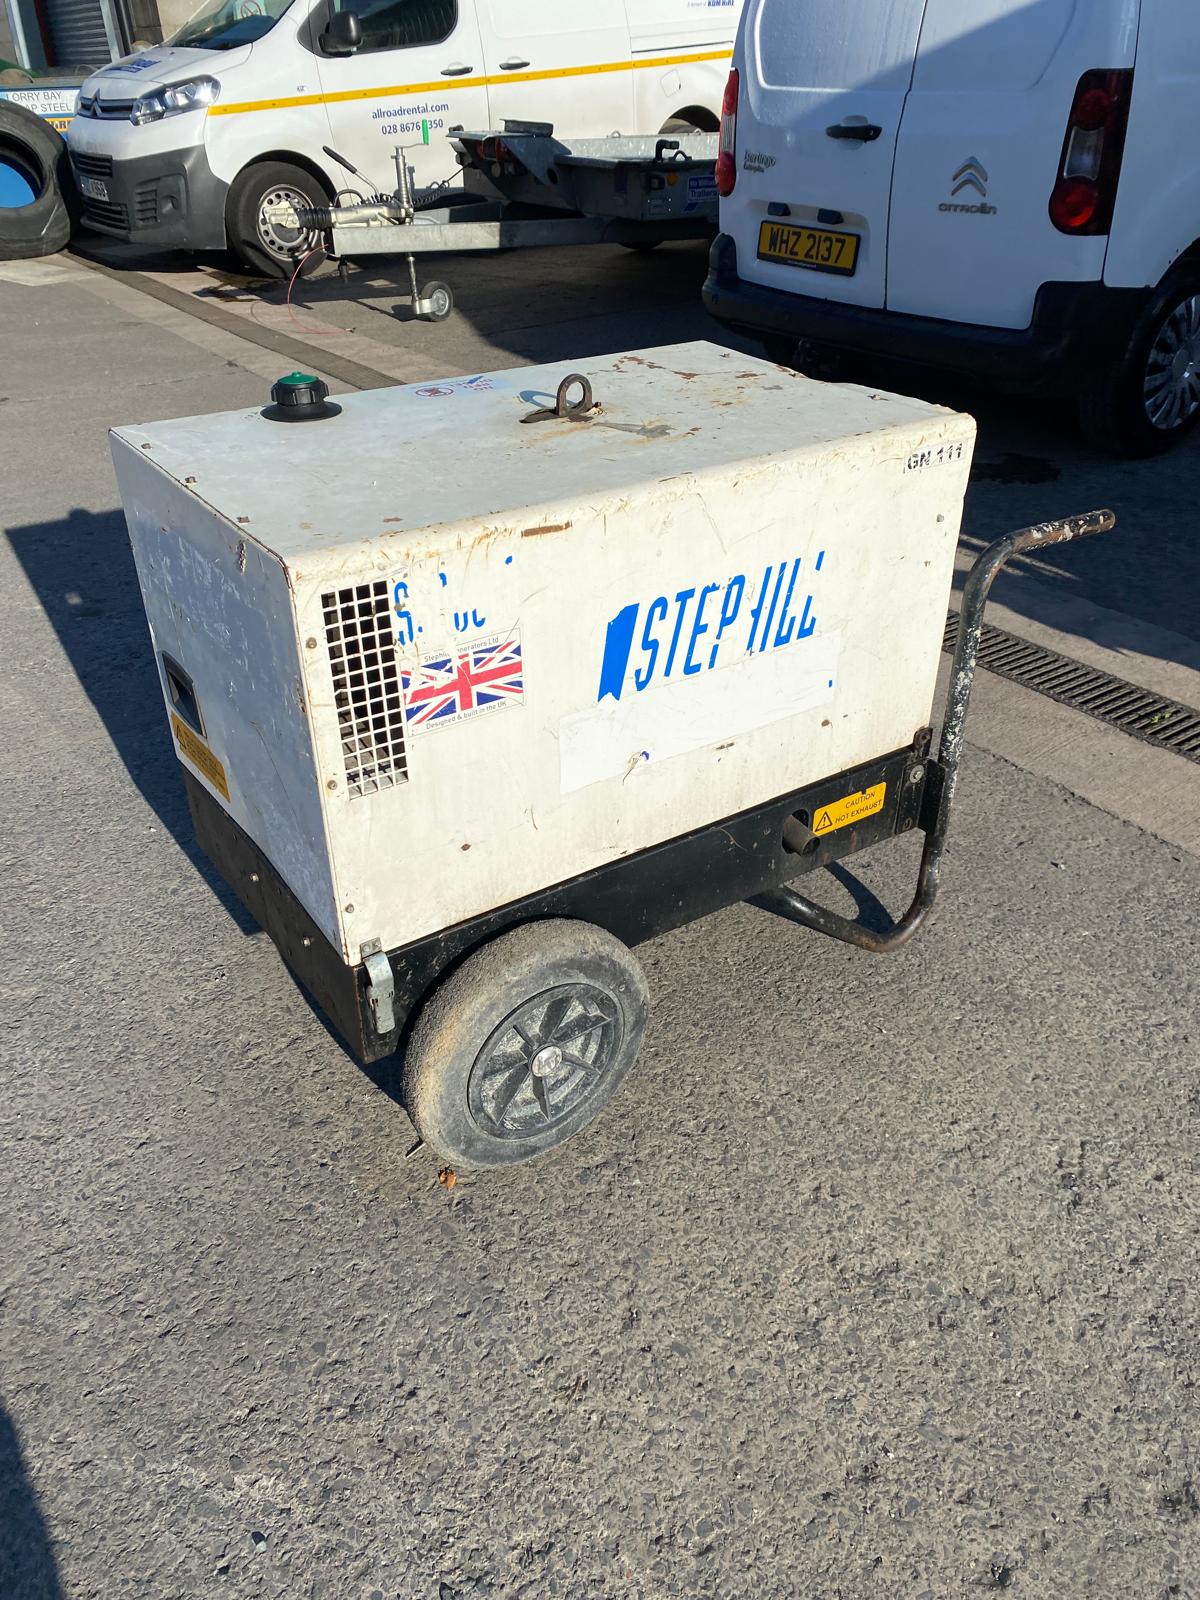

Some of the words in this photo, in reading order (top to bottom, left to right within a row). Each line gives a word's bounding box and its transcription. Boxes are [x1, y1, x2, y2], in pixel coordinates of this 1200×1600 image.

[43, 91, 61, 100] BAY
[41, 103, 72, 112] STEEL
[372, 103, 449, 119] allroadrental.com
[382, 125, 398, 135] 028
[400, 121, 421, 133] 8676
[428, 119, 444, 130] 350
[768, 227, 802, 256] WHZ
[804, 233, 846, 264] 2137
[489, 636, 499, 646] Ltd
[426, 715, 456, 730] Designed
[464, 709, 478, 718] built
[486, 704, 496, 712] the
[497, 700, 507, 708] UK
[845, 792, 876, 809] CAUTION
[835, 813, 849, 824] HOT
[851, 800, 881, 818] EXHAUST
